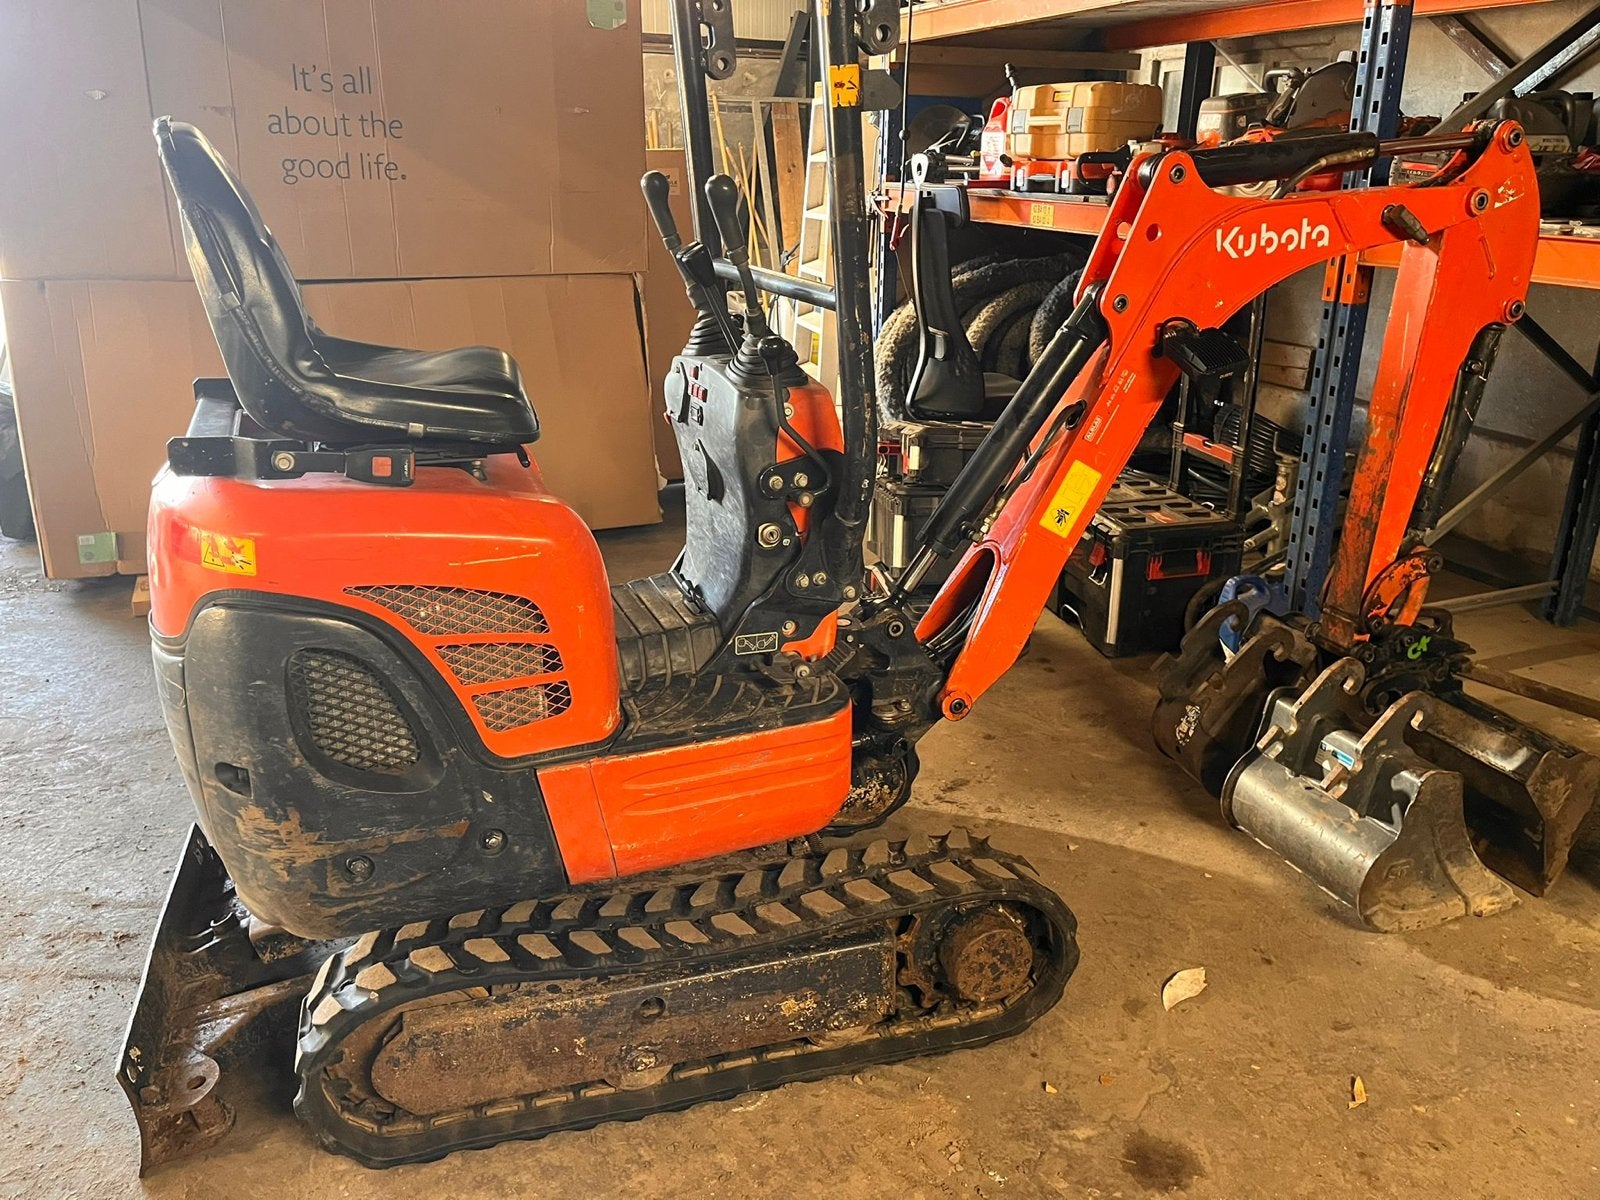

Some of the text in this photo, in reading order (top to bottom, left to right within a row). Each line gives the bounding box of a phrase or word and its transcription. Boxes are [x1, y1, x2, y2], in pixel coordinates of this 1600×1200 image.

[291, 63, 372, 95] It's all
[267, 106, 403, 139] about the
[282, 152, 407, 185] good life.
[1216, 217, 1330, 259] Kubota
